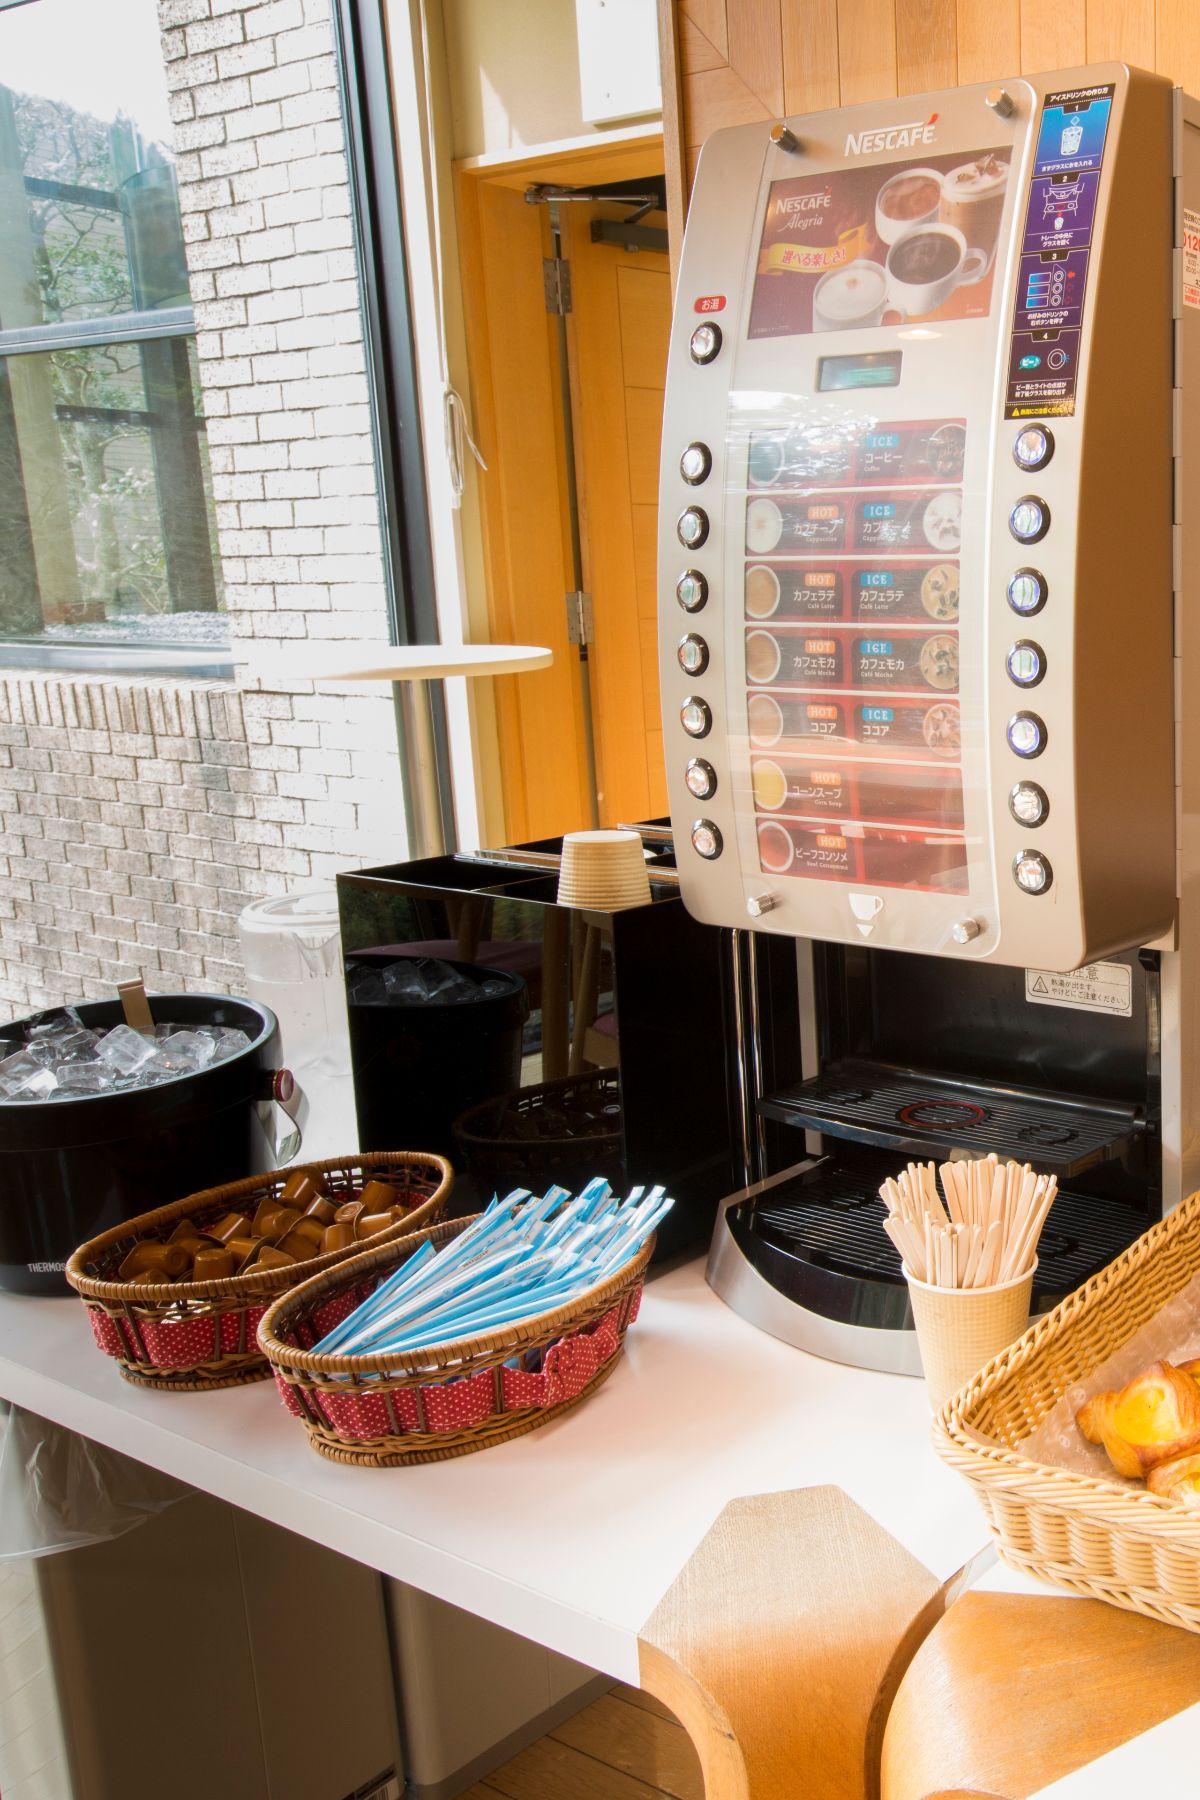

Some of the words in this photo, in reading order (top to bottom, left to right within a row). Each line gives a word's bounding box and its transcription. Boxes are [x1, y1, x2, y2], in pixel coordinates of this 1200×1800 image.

[1050, 87, 1109, 102] アイスドリンクの作り方
[777, 213, 823, 232] Alegria
[701, 298, 720, 311] お湯
[1043, 332, 1048, 340] 4
[872, 435, 893, 447] ICE
[865, 453, 902, 464] コーヒー
[812, 508, 834, 518] HOT
[869, 505, 891, 516] ICE
[809, 575, 832, 585] HOT
[866, 574, 888, 585] ICE
[793, 590, 835, 601] カフェラテ
[860, 590, 905, 602] カフェラテ
[809, 643, 832, 653] HOT
[866, 643, 887, 654] ICE
[793, 656, 836, 669] カフェモカ
[860, 657, 905, 671] カフェモカ
[811, 706, 833, 717] HOT
[868, 710, 889, 721] ICE
[810, 722, 837, 734] ココア
[862, 725, 889, 737] ココア
[815, 773, 837, 784] HOT
[792, 786, 842, 799] コーンスープ
[820, 837, 843, 848] HOT
[796, 848, 848, 862] ビーフコンソメ
